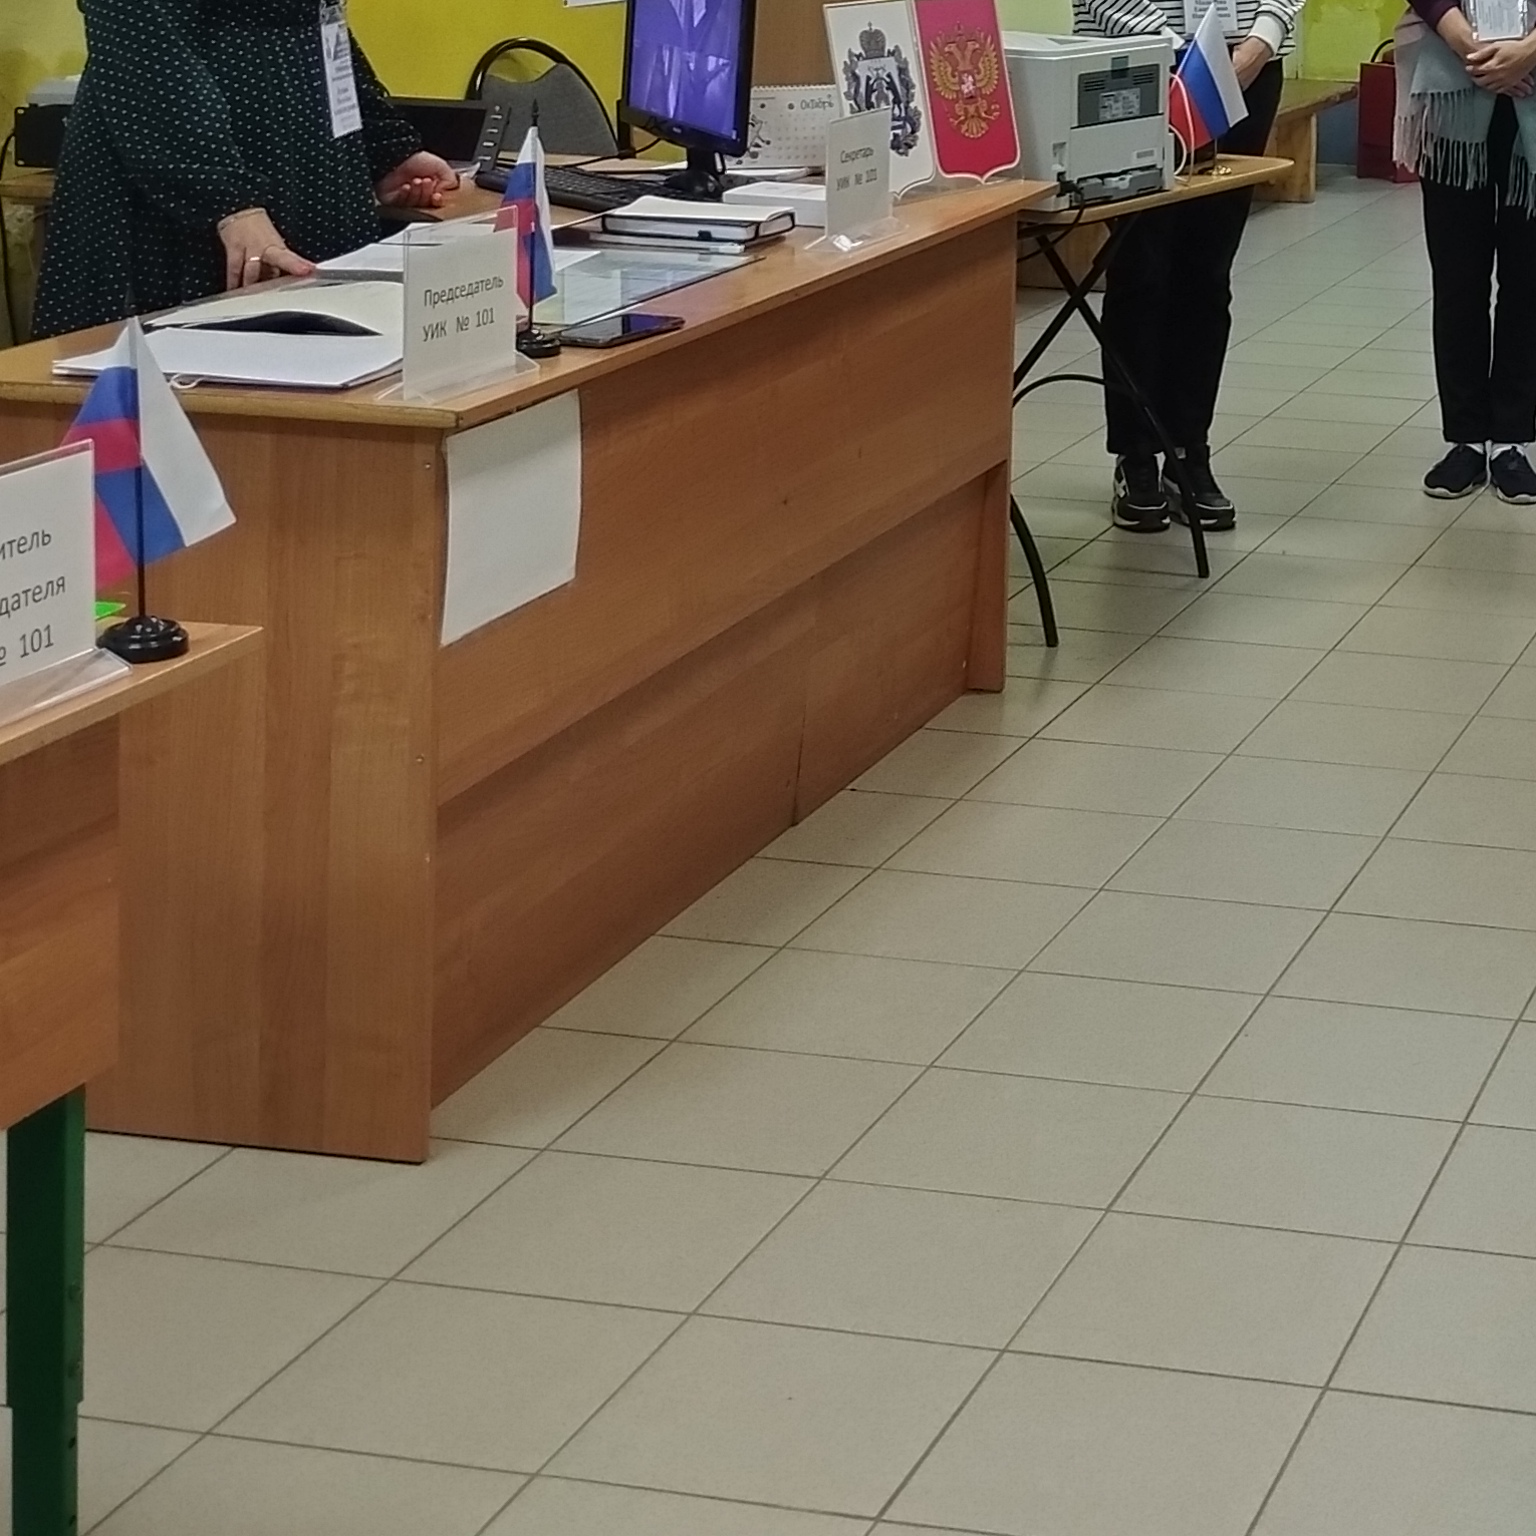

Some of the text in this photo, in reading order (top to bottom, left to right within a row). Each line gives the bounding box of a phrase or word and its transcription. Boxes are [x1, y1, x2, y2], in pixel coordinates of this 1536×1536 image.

[423, 275, 504, 308] Председатель
[422, 307, 495, 342] УИК № 101
[20, 624, 54, 658] 101
